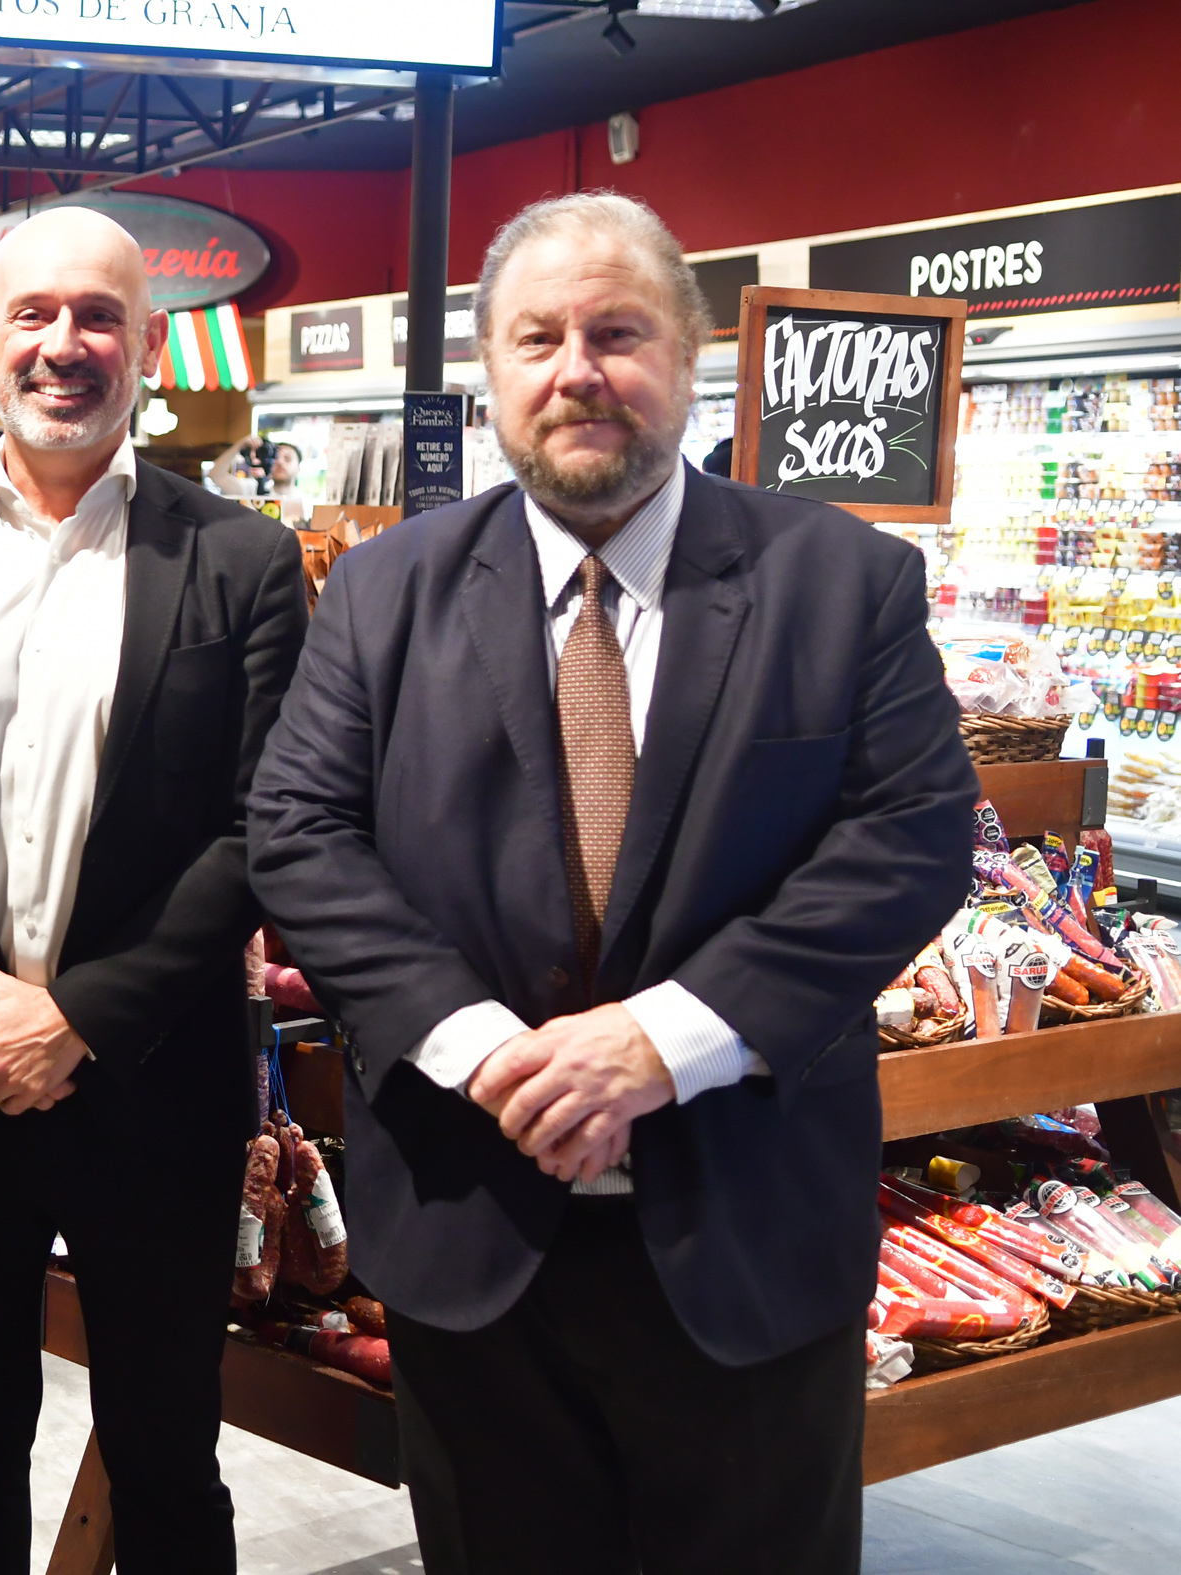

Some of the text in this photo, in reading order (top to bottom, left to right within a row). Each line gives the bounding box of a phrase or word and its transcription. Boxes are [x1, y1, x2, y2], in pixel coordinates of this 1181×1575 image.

[79, 0, 126, 20] DE
[144, 0, 297, 39] GRANJA
[910, 240, 1044, 297] POSTRES
[300, 322, 351, 356] PIZZAS
[763, 313, 933, 418] FACTURAS
[416, 441, 454, 452] RETIRE SU
[438, 485, 462, 499] VIERNES
